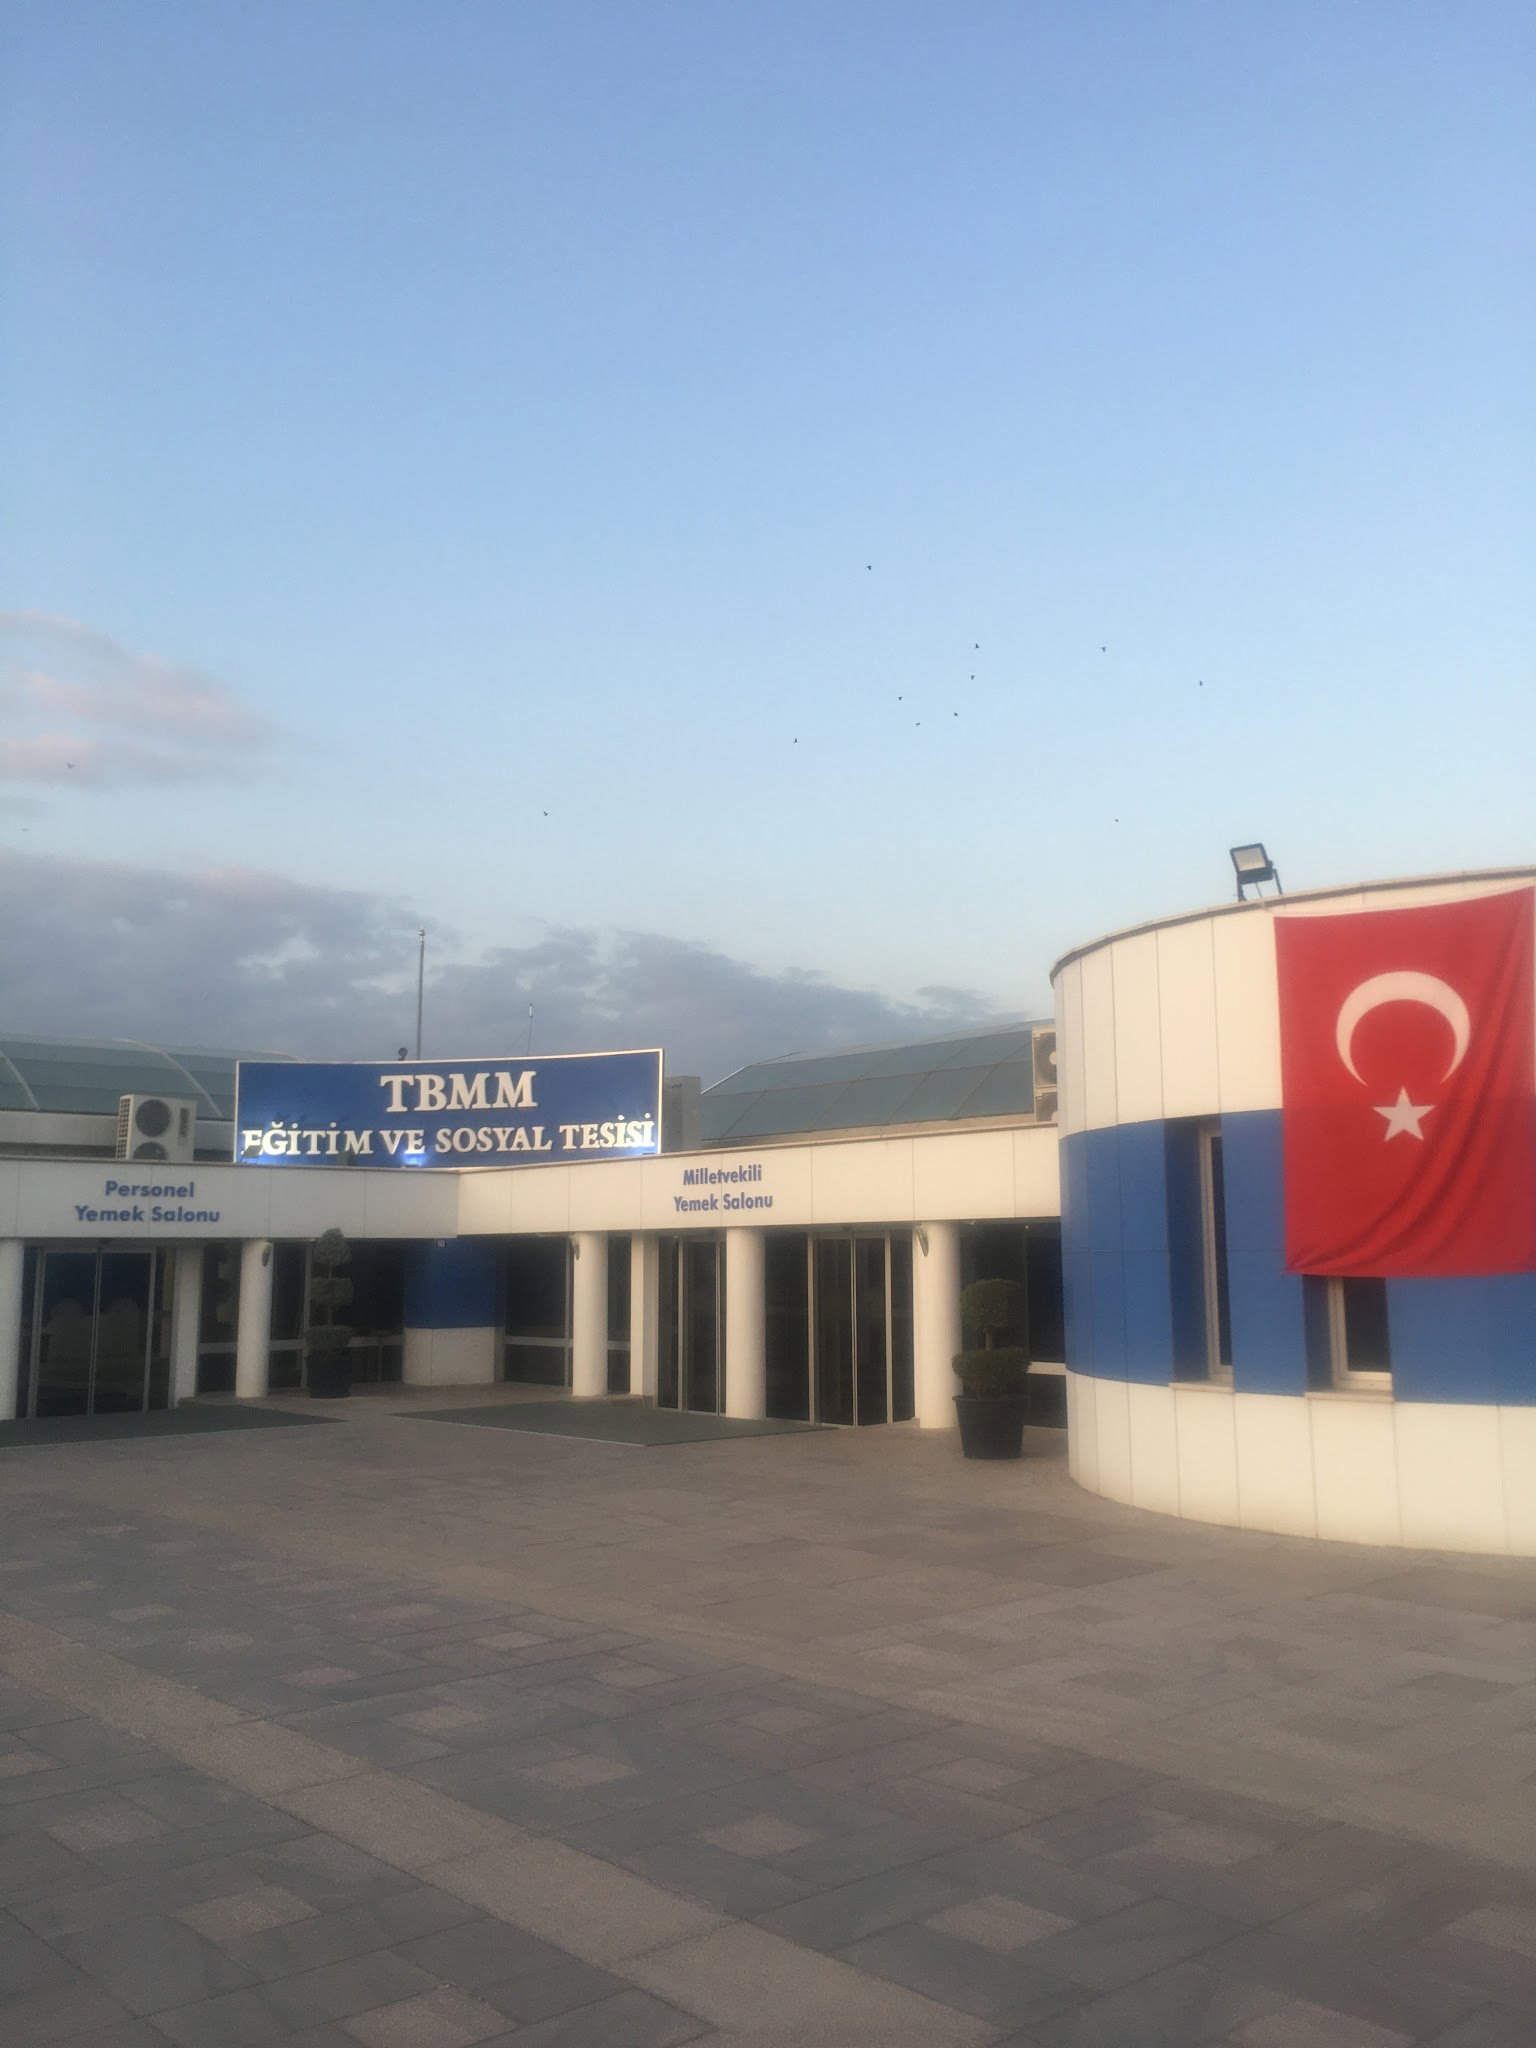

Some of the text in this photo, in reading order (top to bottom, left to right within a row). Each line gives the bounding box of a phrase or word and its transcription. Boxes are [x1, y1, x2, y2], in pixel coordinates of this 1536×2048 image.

[380, 1071, 538, 1113] TBMM
[241, 1112, 655, 1156] EĞİTİM VE SOSYAL TESİSİ
[683, 1164, 762, 1185] Milletvekili
[105, 1180, 194, 1197] Personel
[674, 1192, 773, 1212] Yemek Salonu
[75, 1205, 220, 1222] Yemek Salonu
